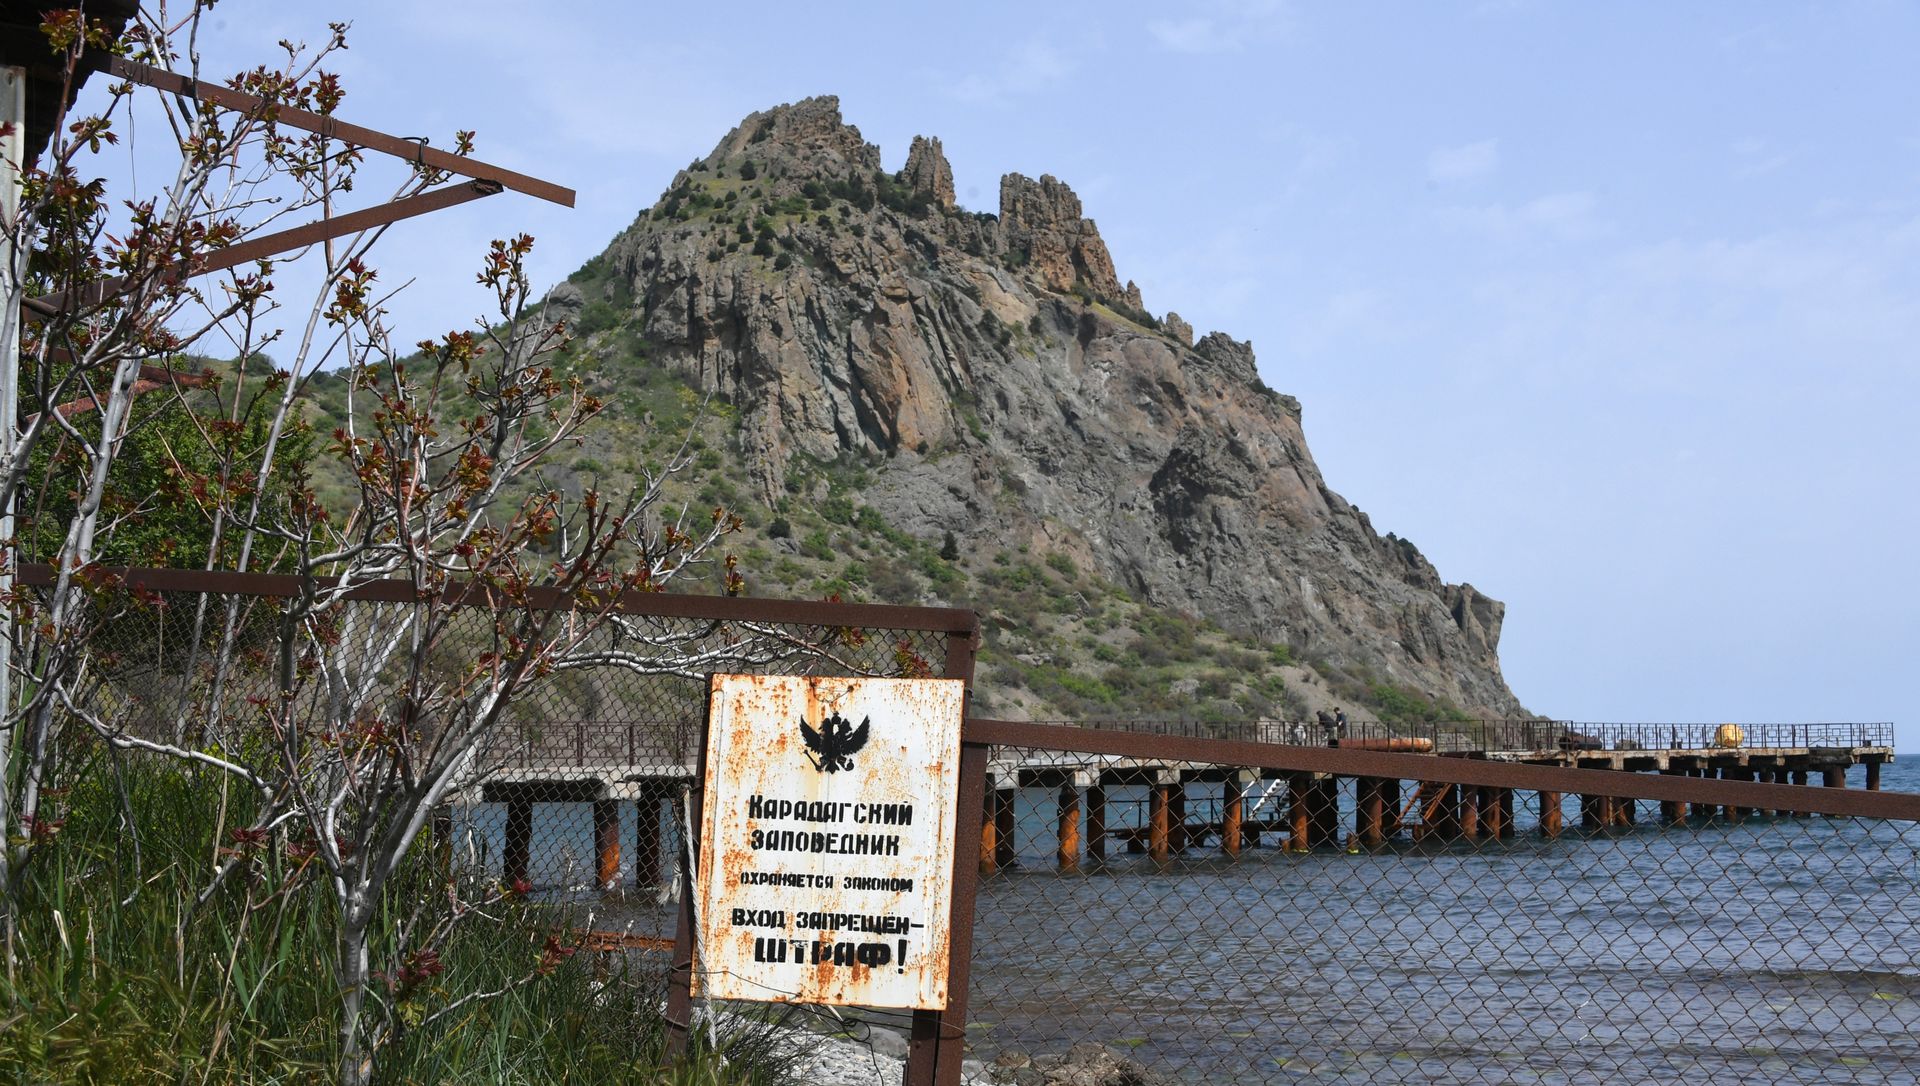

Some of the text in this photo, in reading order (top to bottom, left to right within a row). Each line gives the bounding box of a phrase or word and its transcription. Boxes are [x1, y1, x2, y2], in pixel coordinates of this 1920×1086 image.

[751, 829, 900, 856] ЗАПОВЕДНИК
[740, 871, 914, 893] ОХРАНЯЕТСЯ ЗАКОНОМ
[732, 908, 786, 929] ВХОД
[754, 937, 908, 974] ШТРАФ!
